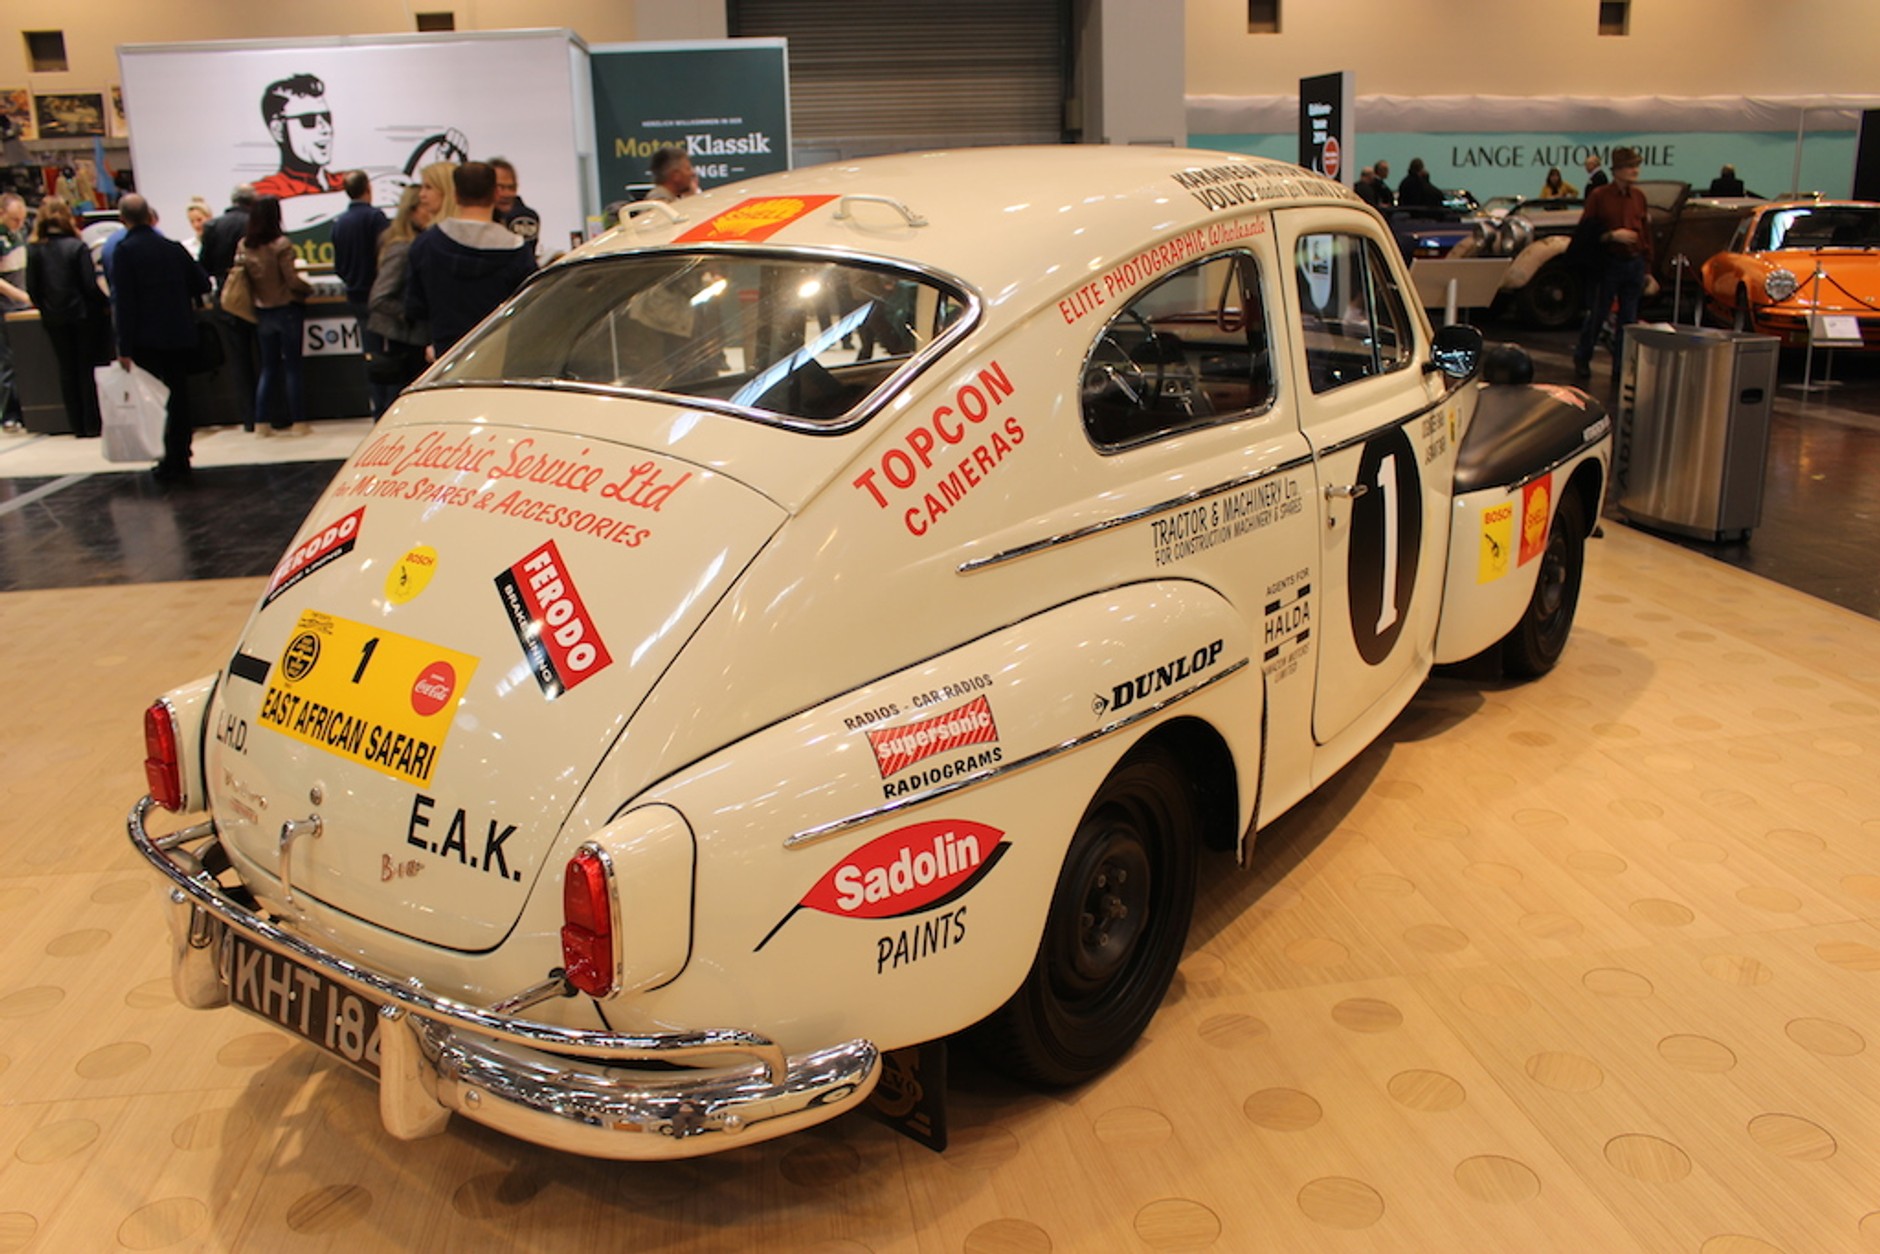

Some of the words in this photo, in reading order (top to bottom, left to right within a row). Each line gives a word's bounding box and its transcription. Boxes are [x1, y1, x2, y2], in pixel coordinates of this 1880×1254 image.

[1452, 146, 1524, 167] LANGE
[1192, 181, 1257, 211] VOLVO
[1058, 283, 1104, 324] ELITE
[1104, 229, 1206, 298] PHOTOGRAPHIC
[852, 360, 1014, 509] TOPCON
[354, 433, 405, 468] Auto
[391, 431, 496, 476] Electric
[488, 438, 603, 492] Service
[601, 461, 693, 512] Ltd
[905, 417, 1025, 537] CAMERAS
[349, 474, 408, 497] MOTOR
[404, 477, 477, 506] SPARES
[473, 492, 495, 510] &
[489, 490, 650, 548] ACCESSORIES
[1151, 506, 1207, 548] TRACTOR
[1212, 501, 1220, 527] &
[1223, 479, 1282, 524] MACHINERY
[1155, 546, 1173, 567] FOR
[1174, 526, 1231, 560] CONSTRUCTION
[1234, 509, 1271, 537] MACHINERY
[1376, 453, 1398, 636] 1
[1485, 508, 1512, 525] BOSCH
[406, 552, 434, 567] BOSCH
[1266, 576, 1295, 597] AGENTS
[523, 551, 597, 671] FERODO
[1265, 601, 1310, 644] HALDA
[352, 637, 380, 684] 1
[529, 634, 552, 682] LINING
[1111, 639, 1223, 712] DUNLOP
[261, 688, 301, 728] EAST
[294, 700, 368, 755] AFRICAN
[365, 725, 436, 780] SAFARI
[843, 704, 900, 730] RADIOS
[912, 690, 942, 709] CAR
[942, 674, 993, 698] RADIOS
[878, 711, 990, 758] supersonic
[883, 747, 1002, 799] RADIOGRAMS
[407, 793, 522, 882] E.A.K.
[834, 832, 980, 911] Sadolin
[877, 905, 967, 974] PAINTS
